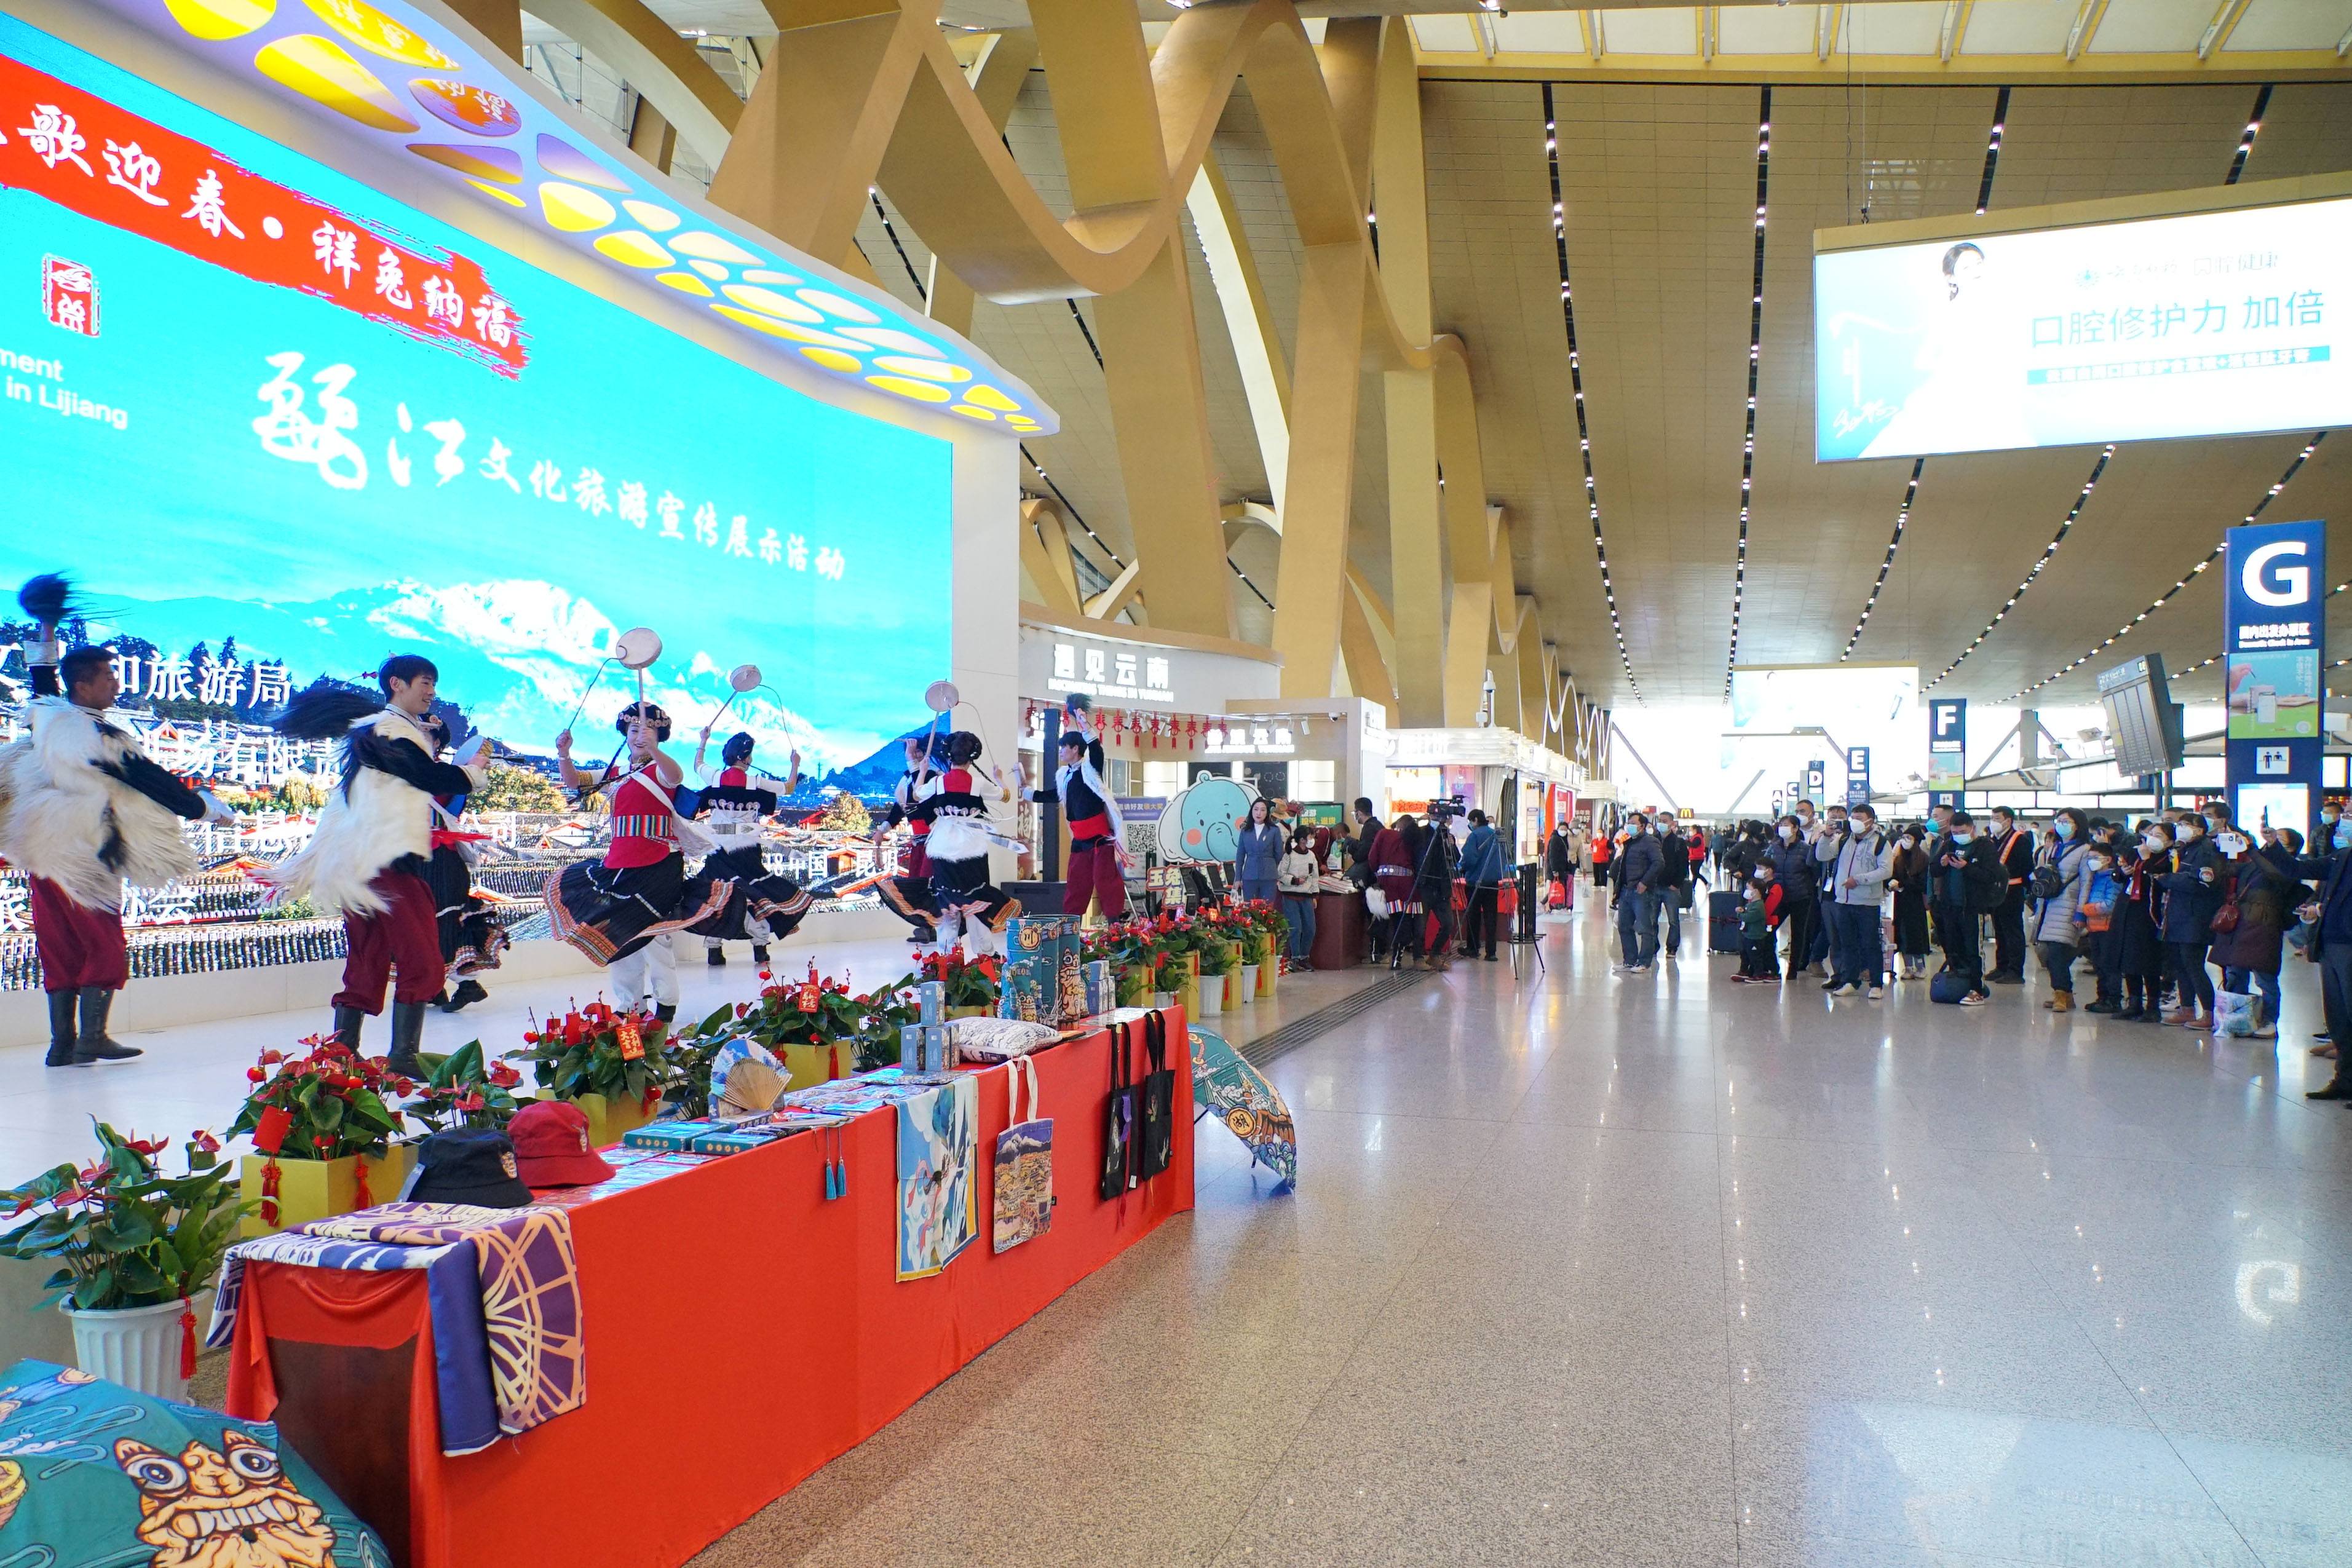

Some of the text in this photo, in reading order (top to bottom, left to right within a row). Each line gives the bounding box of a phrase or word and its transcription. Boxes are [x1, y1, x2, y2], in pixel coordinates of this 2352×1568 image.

[0, 103, 515, 349] 歌迎春·祥兔纳福
[2032, 288, 2324, 348] 口腔修护力 加倍
[6, 375, 128, 430] in Lijiang
[2241, 541, 2308, 607] G
[1937, 705, 1957, 735] F
[1808, 770, 1823, 786] D
[1851, 750, 1865, 770] E
[1787, 783, 1798, 796] C
